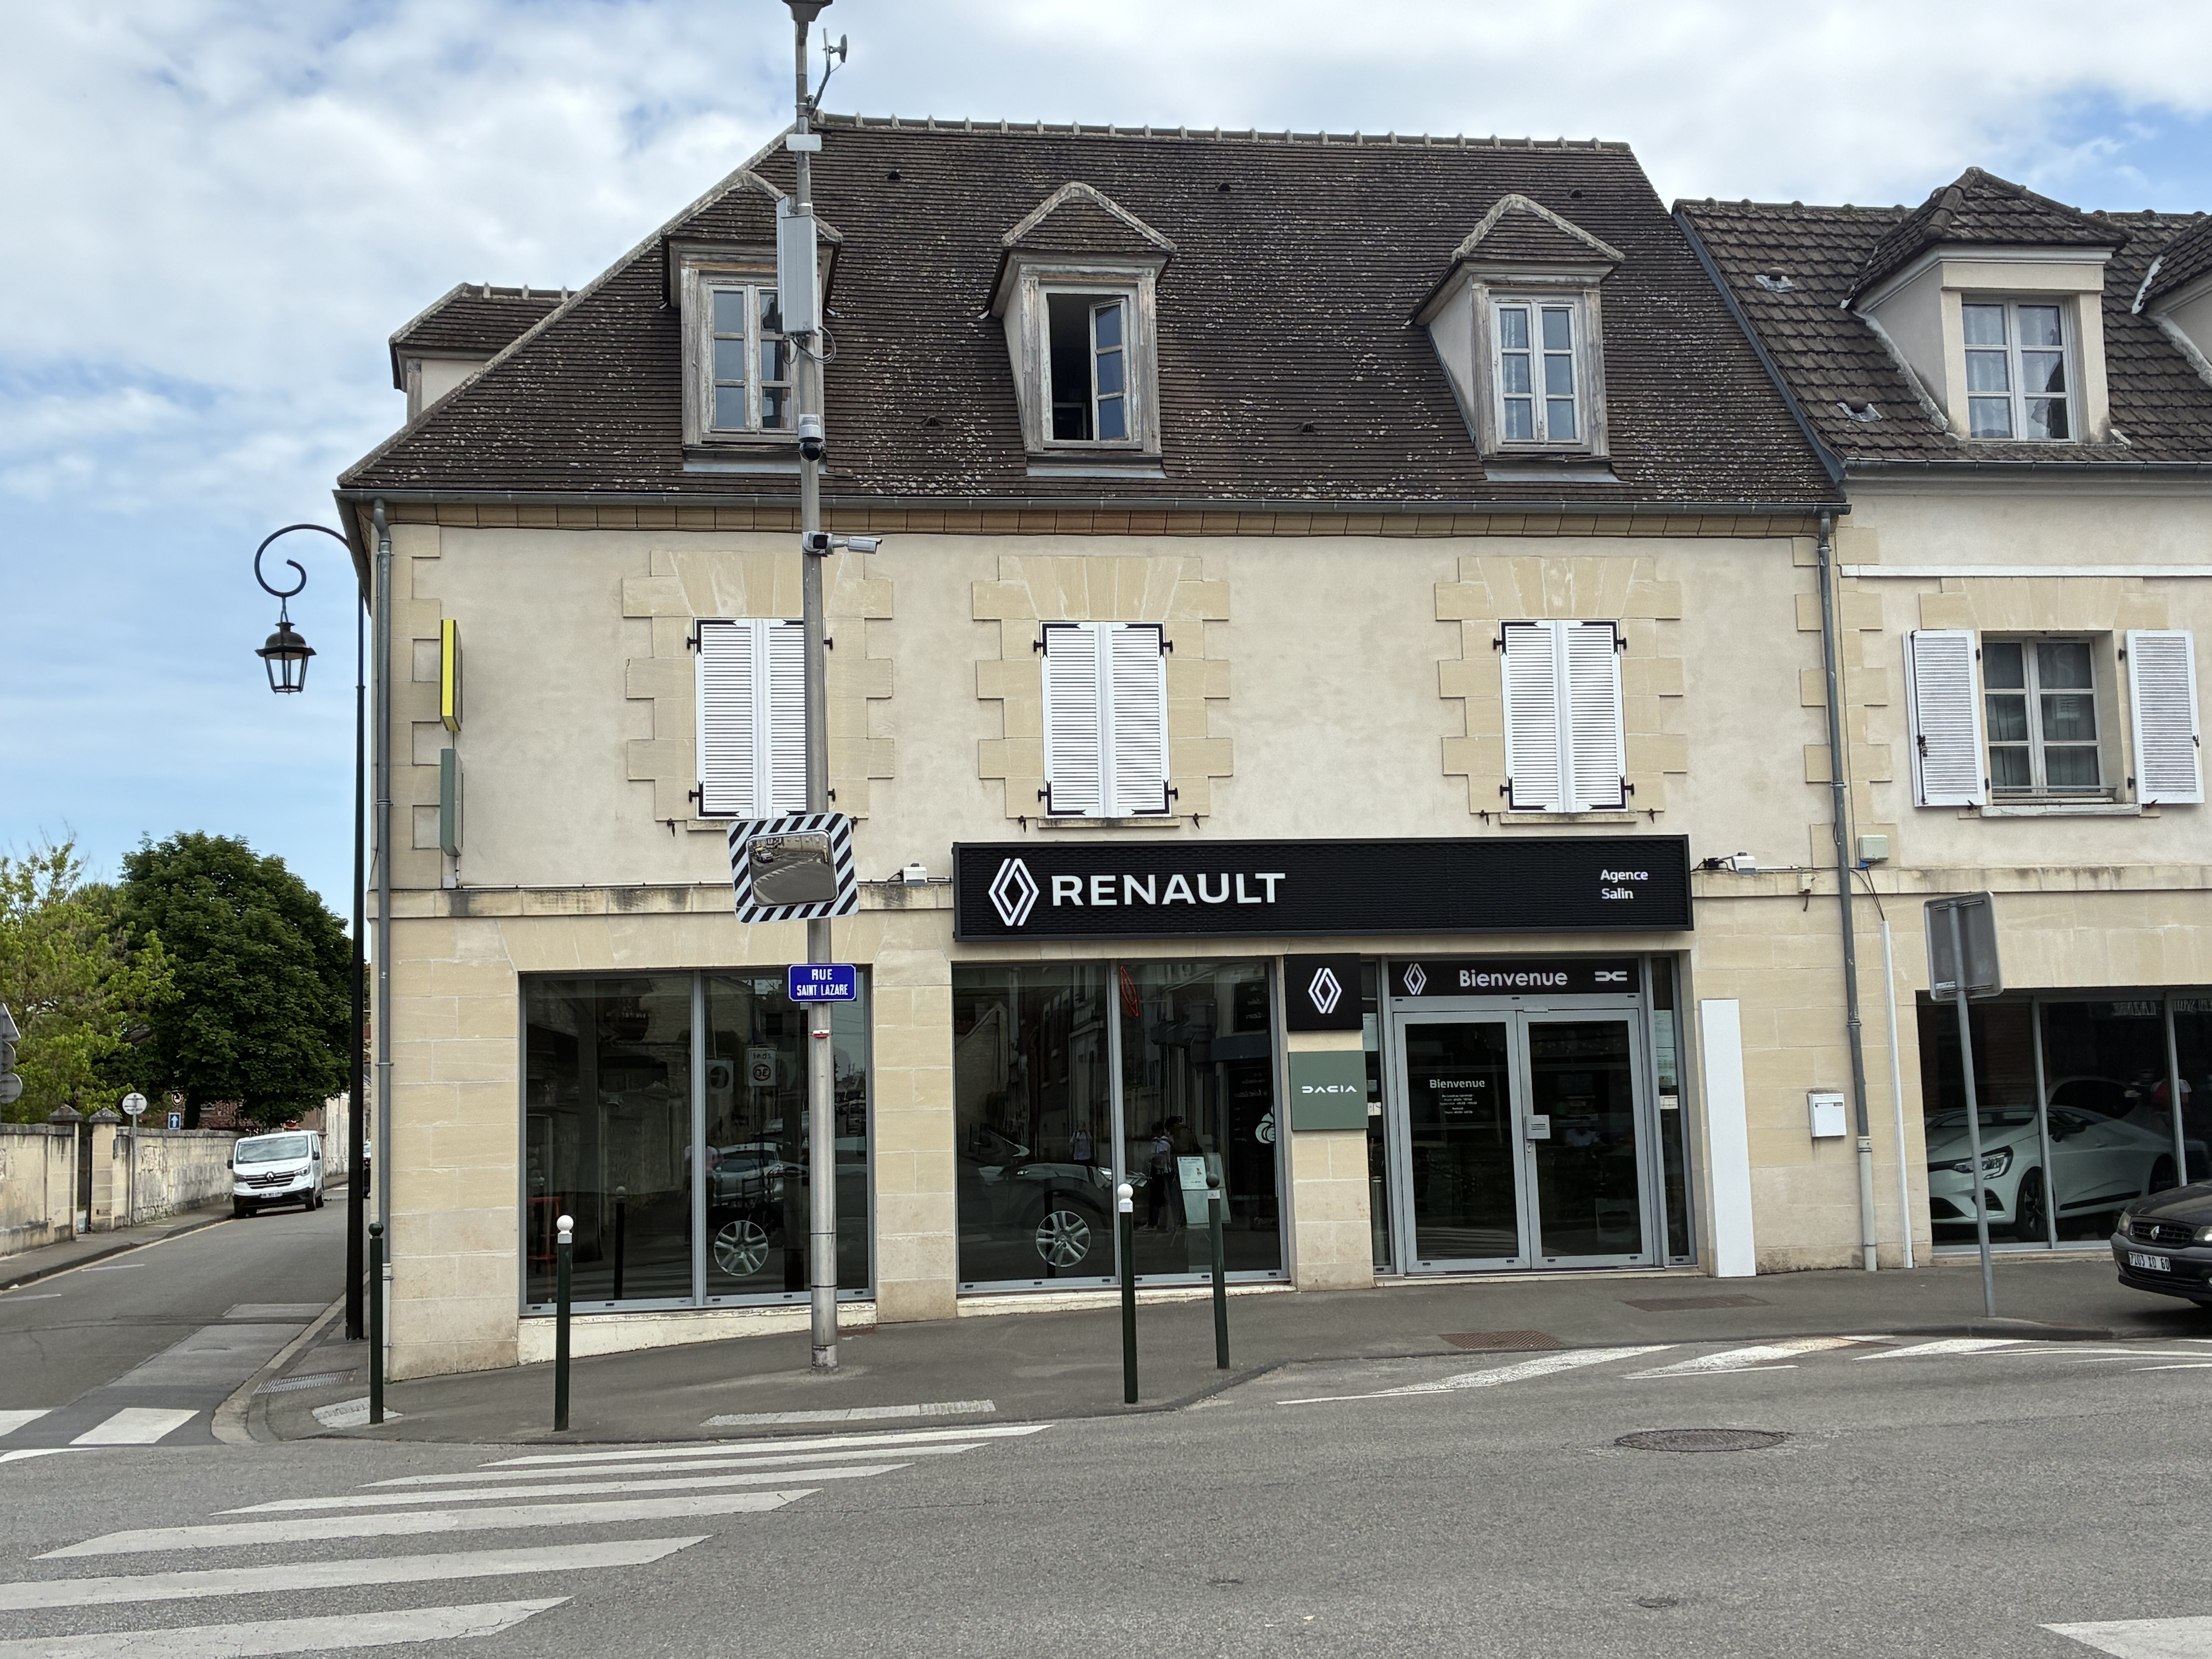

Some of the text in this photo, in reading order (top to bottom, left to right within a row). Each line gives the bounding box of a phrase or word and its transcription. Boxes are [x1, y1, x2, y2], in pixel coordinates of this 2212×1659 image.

[1600, 869, 1648, 883] Agence
[1051, 873, 1286, 906] RENAULT
[1601, 887, 1634, 899] Salin
[811, 968, 833, 981] RUE
[1459, 969, 1568, 987] Bienvenue
[796, 983, 848, 996] SAINT LAZARE
[1302, 1084, 1357, 1094] DACIA
[1429, 1078, 1485, 1089] Bienvenue
[2160, 1258, 2170, 1270] 60
